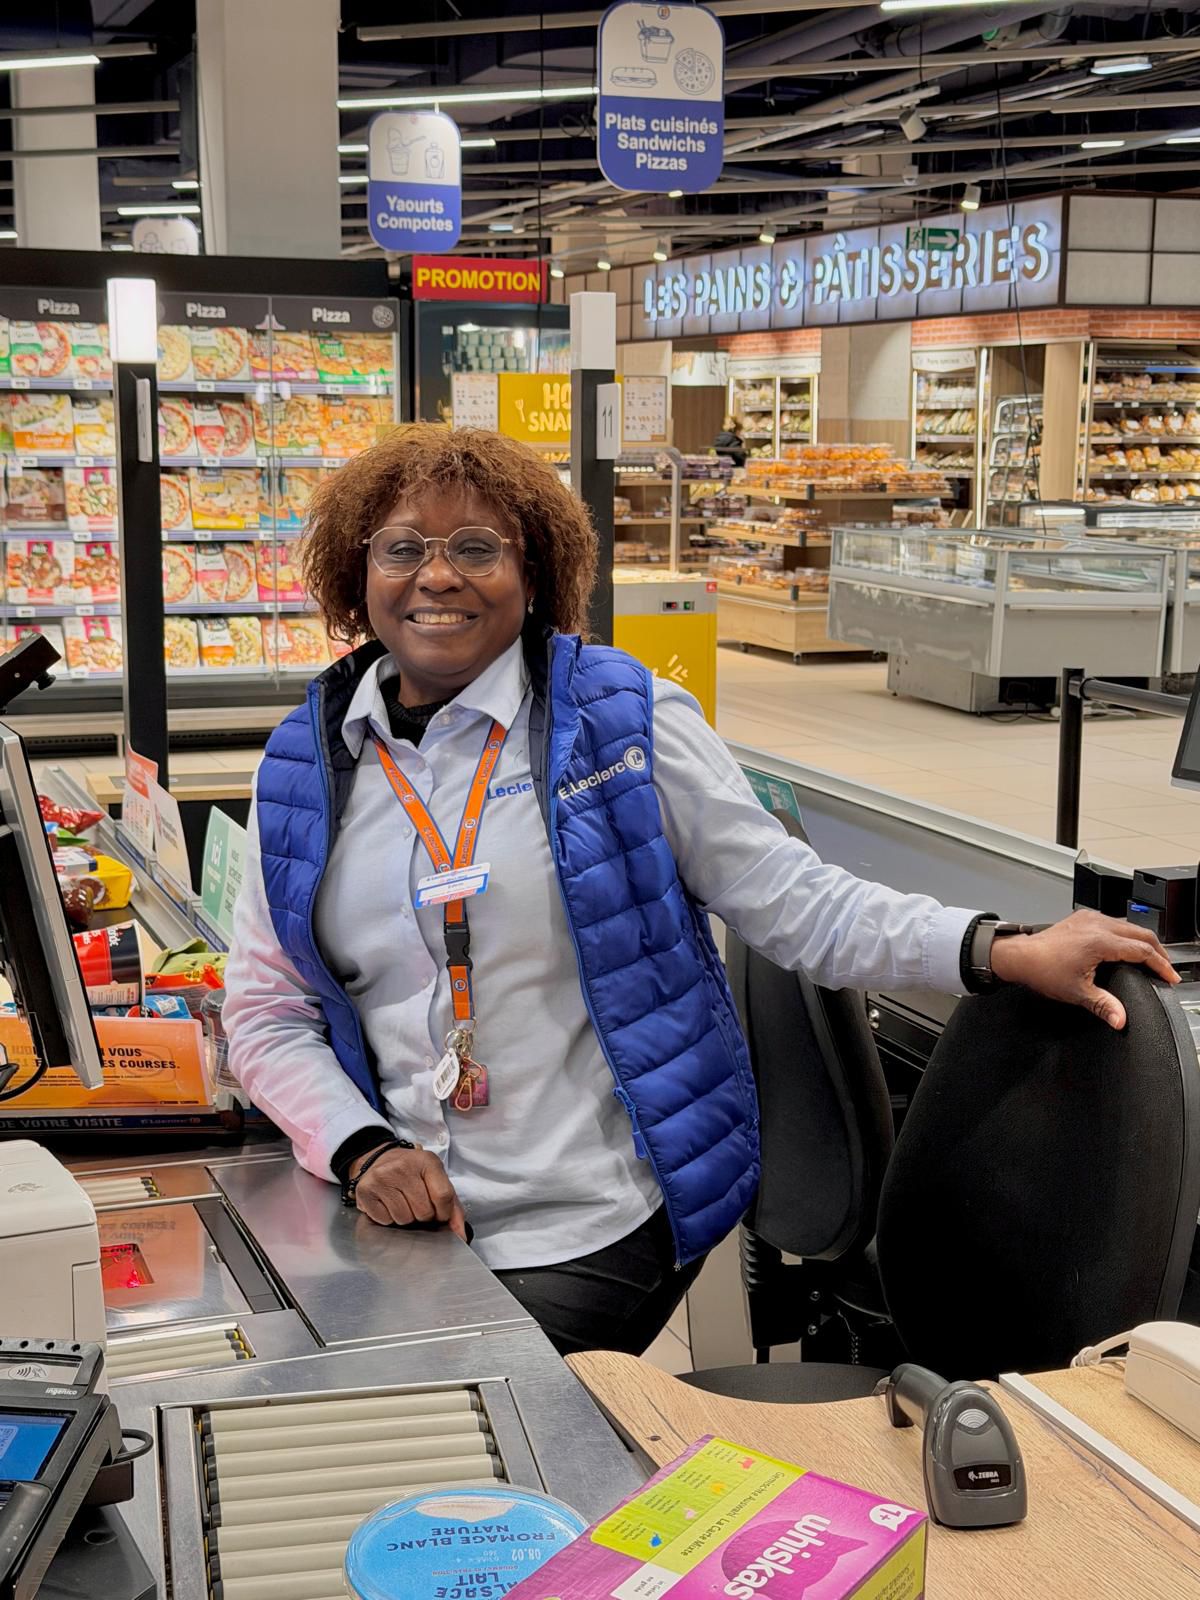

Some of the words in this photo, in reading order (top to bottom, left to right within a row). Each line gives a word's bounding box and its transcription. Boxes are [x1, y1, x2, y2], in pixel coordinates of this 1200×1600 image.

[605, 113, 646, 131] Plats
[651, 116, 718, 134] cuisinés
[617, 133, 706, 153] Sandwichs
[636, 153, 687, 170] Pizzas
[386, 195, 444, 214] Yaourts
[376, 212, 454, 233] Compotes
[417, 267, 540, 291] PROMOTION
[643, 272, 687, 321] LES
[694, 261, 771, 317] PAINS
[780, 258, 801, 310] &
[812, 221, 1051, 304] PÂTISSERIES
[37, 299, 80, 315] Pizza
[186, 302, 226, 319] Pizza
[312, 307, 350, 323] Pizza
[602, 404, 613, 438] 11
[108, 1048, 142, 1057] VOUS
[120, 1060, 180, 1069] COURSES.
[19, 1118, 70, 1128] VOTRE
[74, 1117, 123, 1127] VISITE
[978, 1470, 999, 1479] ZEBRA
[879, 1508, 901, 1521] 1+
[431, 1525, 510, 1536] NATURE
[459, 1532, 556, 1544] FROMAGE
[386, 1536, 452, 1552] BLANC
[511, 1548, 541, 1561] 08.02
[723, 1513, 832, 1600] whiskas
[456, 1572, 499, 1587] LAIT
